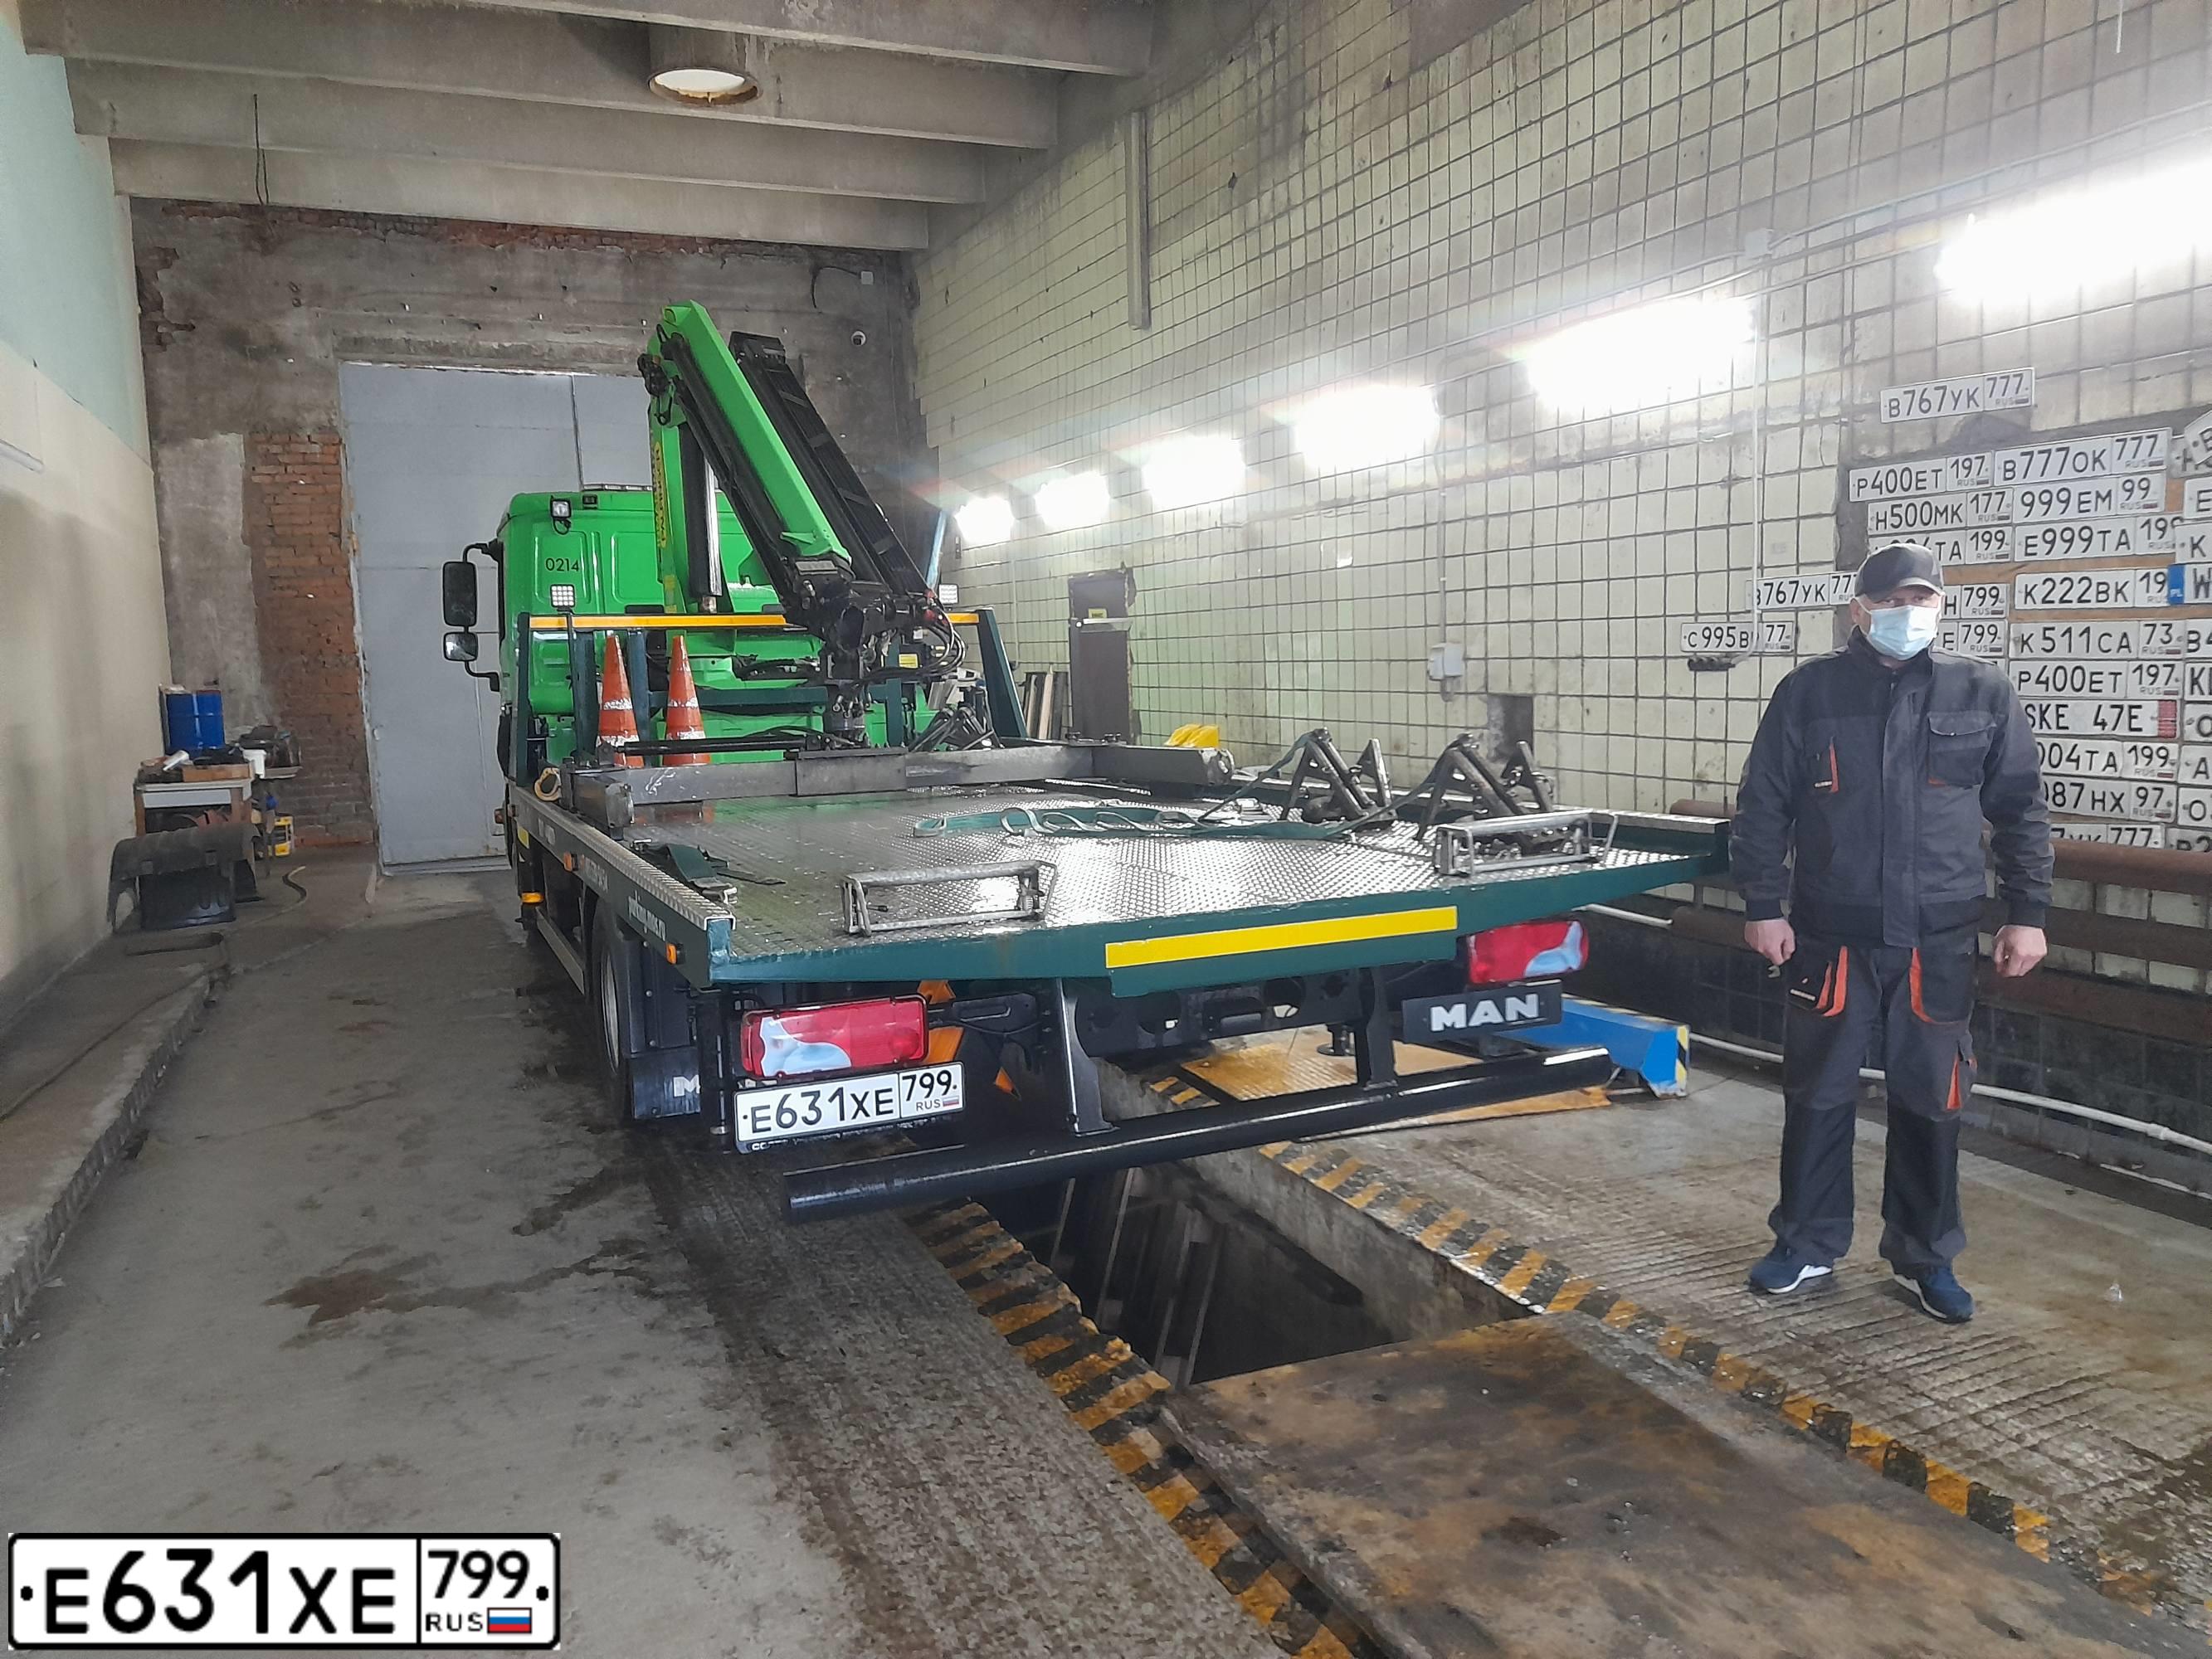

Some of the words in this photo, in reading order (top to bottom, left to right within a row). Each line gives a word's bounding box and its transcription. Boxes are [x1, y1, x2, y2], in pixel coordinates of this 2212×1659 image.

[1888, 385, 1980, 417] В767УК
[1986, 373, 2024, 398] 777
[2003, 446, 2107, 481] В777ОК
[2115, 435, 2158, 460] 777
[1857, 467, 1943, 498] Р400ЕТ
[1951, 455, 1986, 479] 197
[2122, 477, 2151, 501] 99
[1875, 500, 1963, 531] Н500МК
[1970, 491, 2006, 513] 177
[1969, 530, 2005, 551] 199
[2024, 526, 2131, 556] Е999ТА
[545, 557, 579, 572] 0214
[1832, 573, 1857, 594] 77
[1963, 586, 2000, 607] 799
[2024, 577, 2130, 604] К222ВК
[1766, 625, 1786, 641] 77
[1961, 624, 1998, 644] 799
[2020, 625, 2132, 654] К511СА
[2144, 623, 2172, 645] 73
[2018, 664, 2122, 693] Р400ЕТ
[2132, 664, 2175, 686] 197
[2093, 704, 2143, 732] 47E
[2127, 745, 2169, 767] 199
[2136, 786, 2164, 808] 97
[1430, 994, 1539, 1032] MAN
[751, 1087, 894, 1134] Е631ХЕ
[902, 1069, 953, 1102] 799
[915, 1098, 941, 1112] RUS
